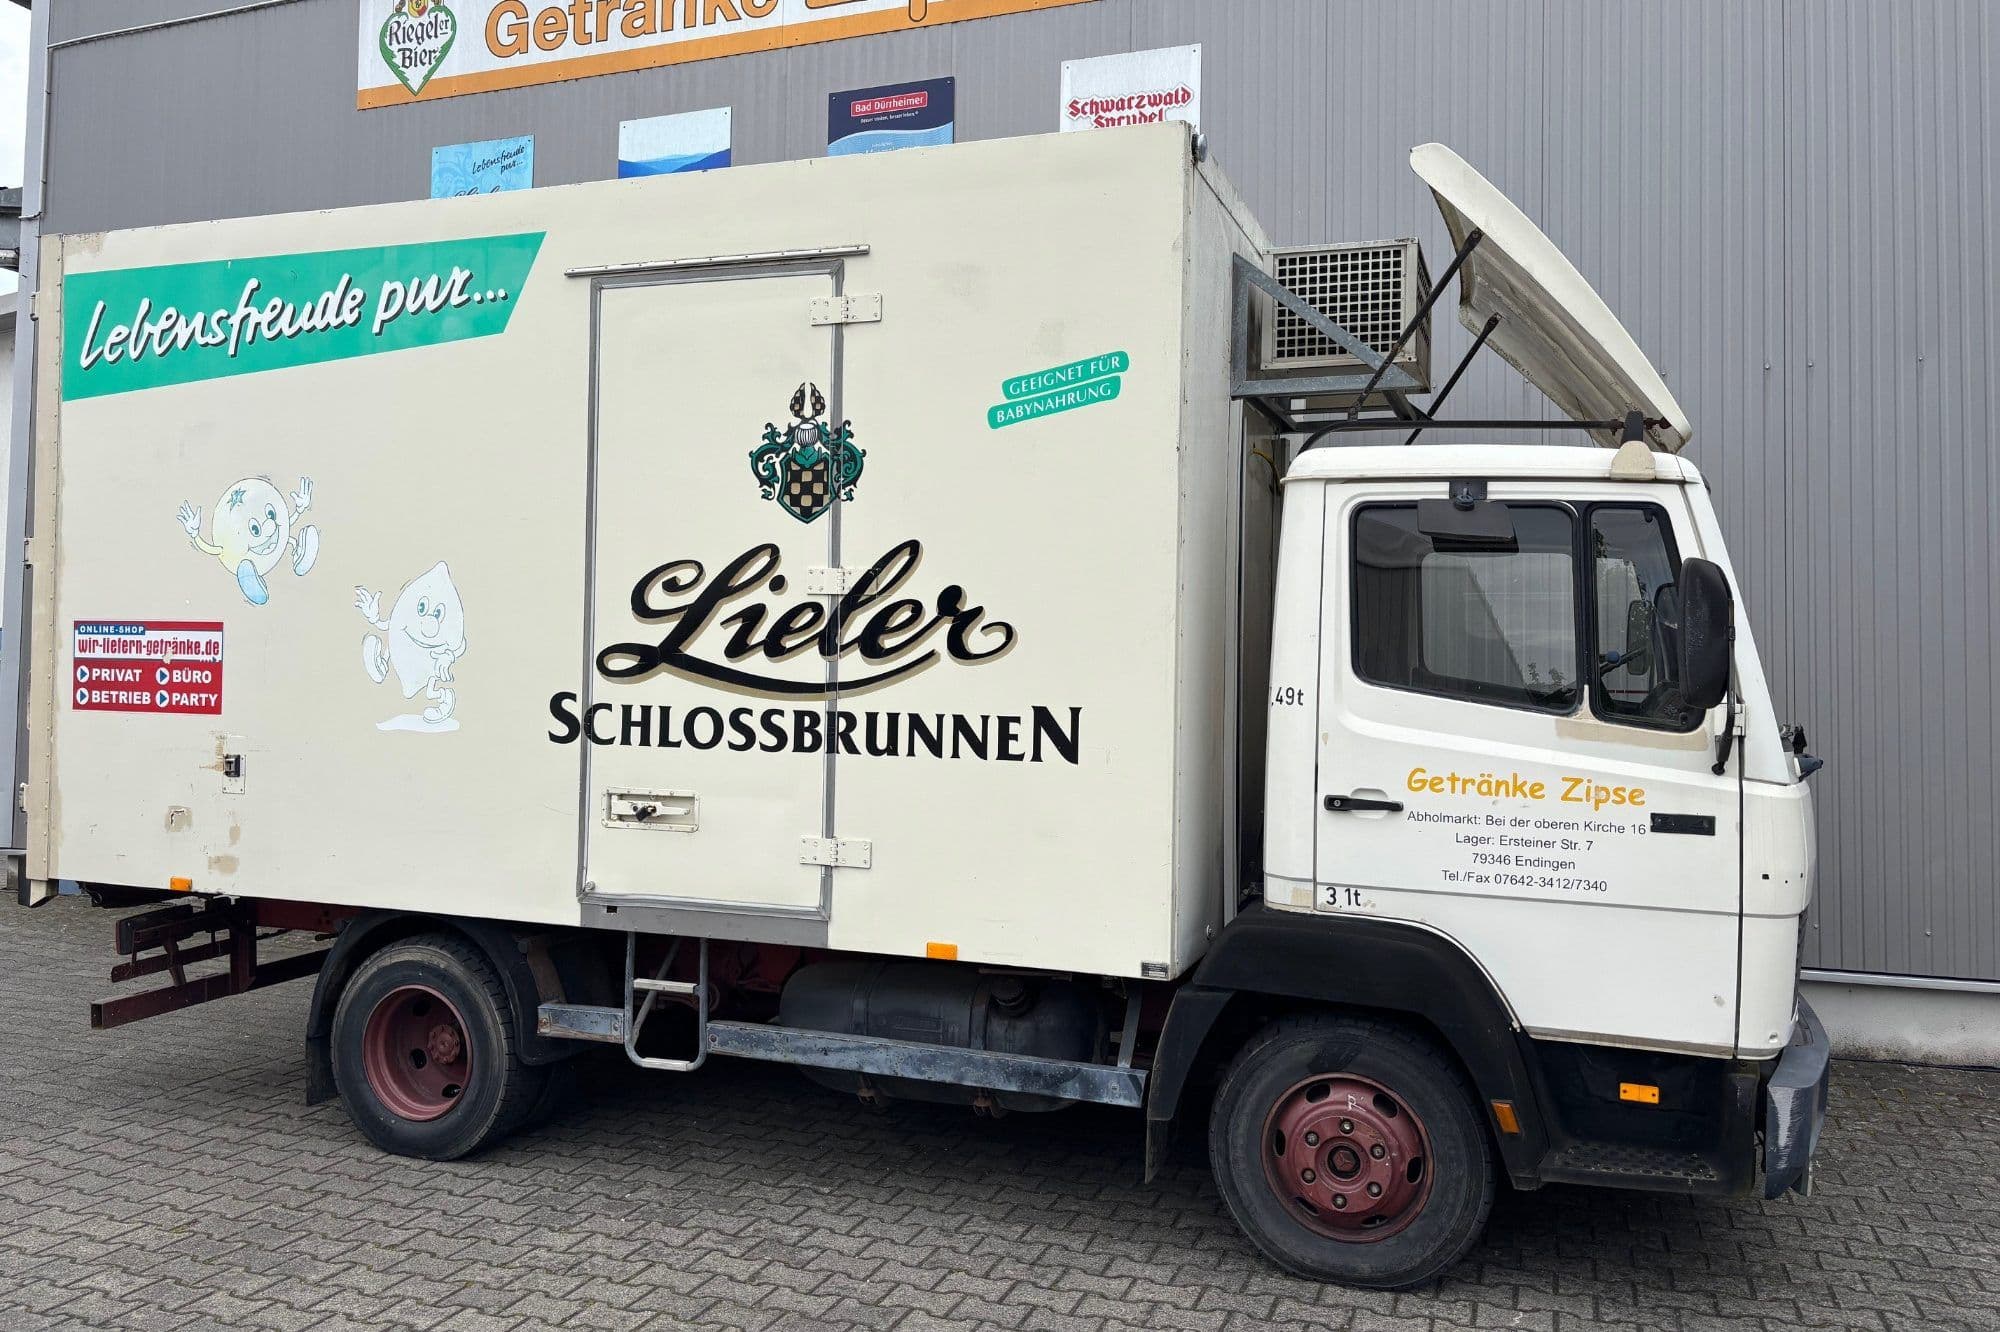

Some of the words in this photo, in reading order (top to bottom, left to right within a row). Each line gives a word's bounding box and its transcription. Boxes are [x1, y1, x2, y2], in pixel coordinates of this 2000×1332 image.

[388, 13, 450, 46] Riegeler
[397, 46, 439, 69] Bier
[855, 102, 872, 113] Bad
[1068, 86, 1192, 118] Schwarzwald
[80, 272, 366, 371] Lebensfreude
[1009, 364, 1085, 395] GEEIGNET
[1090, 355, 1121, 375] FÜR
[996, 382, 1112, 423] BABYNAHRUNG
[79, 625, 144, 634] ONLINE-SHOP
[596, 539, 1018, 700] Lieler
[78, 637, 220, 656] wir-liefern-getränke.de
[92, 669, 143, 682] PRIVAT
[172, 668, 212, 683] BÜRO
[91, 690, 151, 705] BETRIEB
[172, 692, 219, 707] PARTY
[548, 691, 1083, 765] SCHLOSSBRUNNEN
[1407, 767, 1546, 800] Getränke
[1560, 776, 1646, 811] Zipse
[1407, 811, 1481, 825] Abholmarkt:
[1485, 815, 1506, 826] Bei
[1509, 817, 1531, 828] der
[1534, 818, 1579, 831] oberen
[1583, 820, 1626, 834] Kirche
[1631, 824, 1647, 835] 16
[1455, 832, 1495, 847] Lager:
[1499, 835, 1557, 849] Ersteiner
[1560, 838, 1581, 851] Str.
[1586, 840, 1594, 851] 7
[1472, 852, 1511, 866] 79346
[1515, 855, 1576, 871] Endingen
[1441, 870, 1491, 884] Tel./Fax
[1494, 873, 1608, 892] 07642-3412/7340
